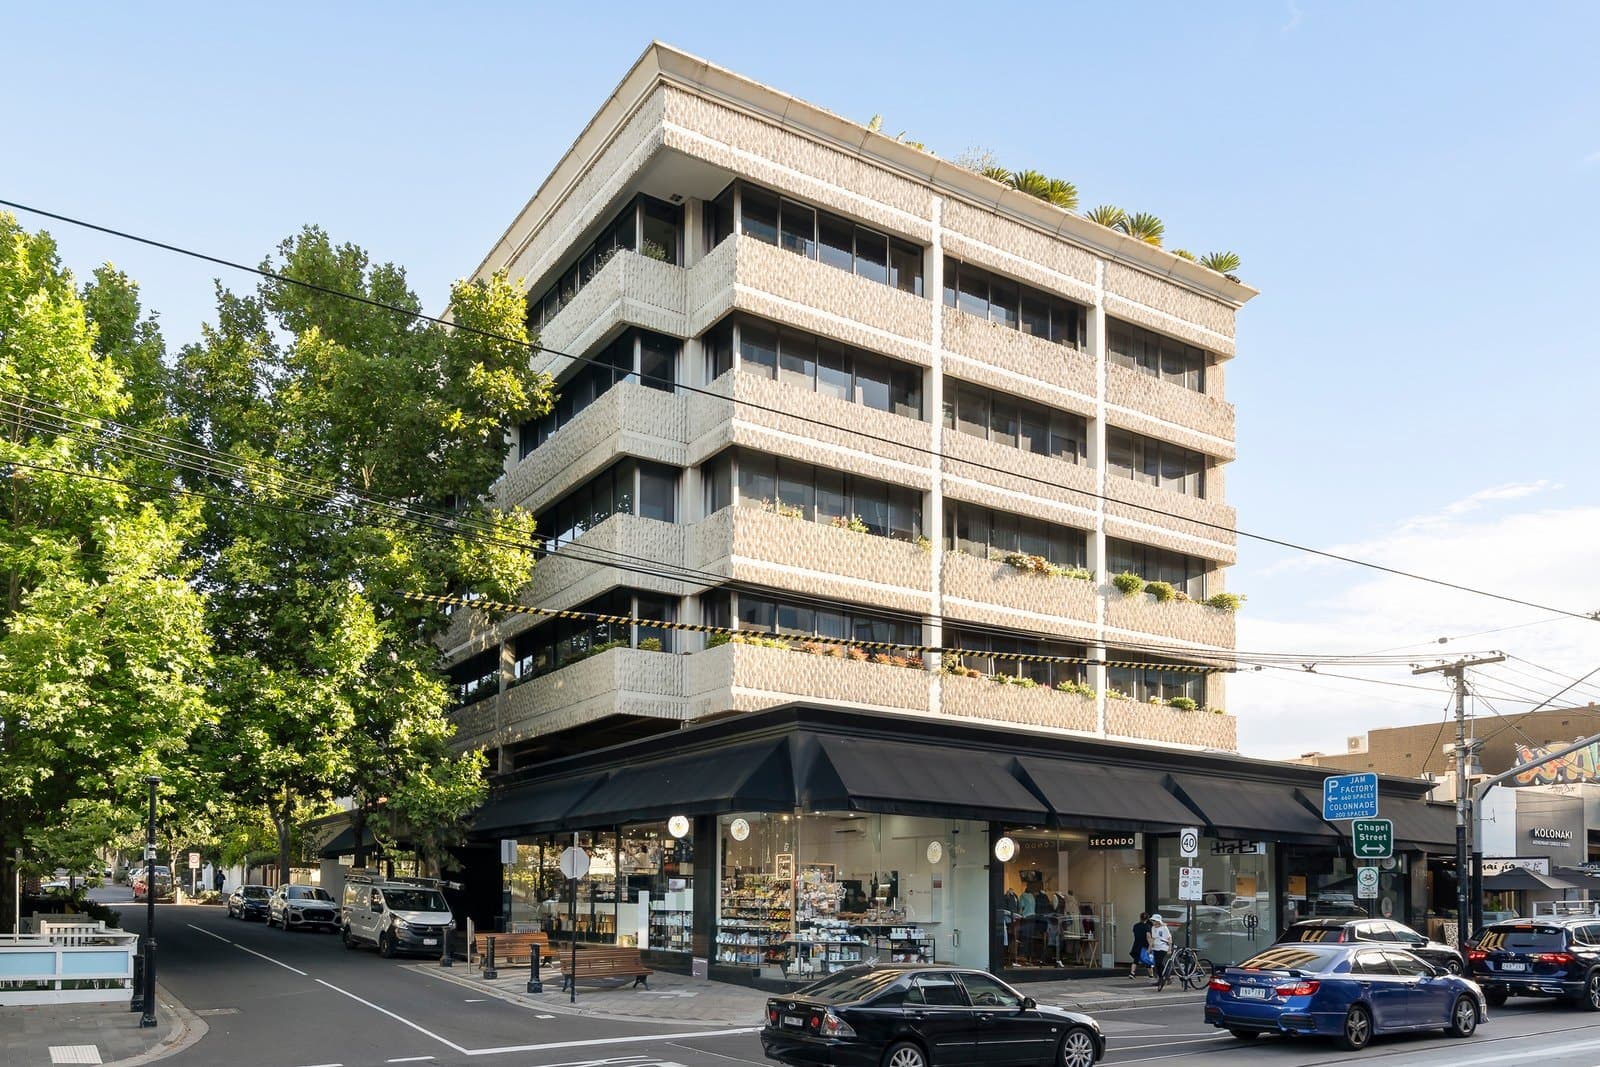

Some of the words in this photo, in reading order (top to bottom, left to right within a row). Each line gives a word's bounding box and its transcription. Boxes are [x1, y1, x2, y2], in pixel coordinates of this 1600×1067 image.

[1350, 775, 1366, 784] JAM
[1328, 780, 1339, 793] P
[1340, 784, 1374, 794] FACTORY
[1352, 792, 1374, 800] SPACES
[1329, 801, 1375, 811] COLONNADE
[1357, 823, 1388, 832] Chapel
[1359, 833, 1387, 841] Street
[1534, 827, 1573, 839] KOLONAKI
[1090, 838, 1134, 846] SECONDO
[1184, 838, 1195, 848] 40
